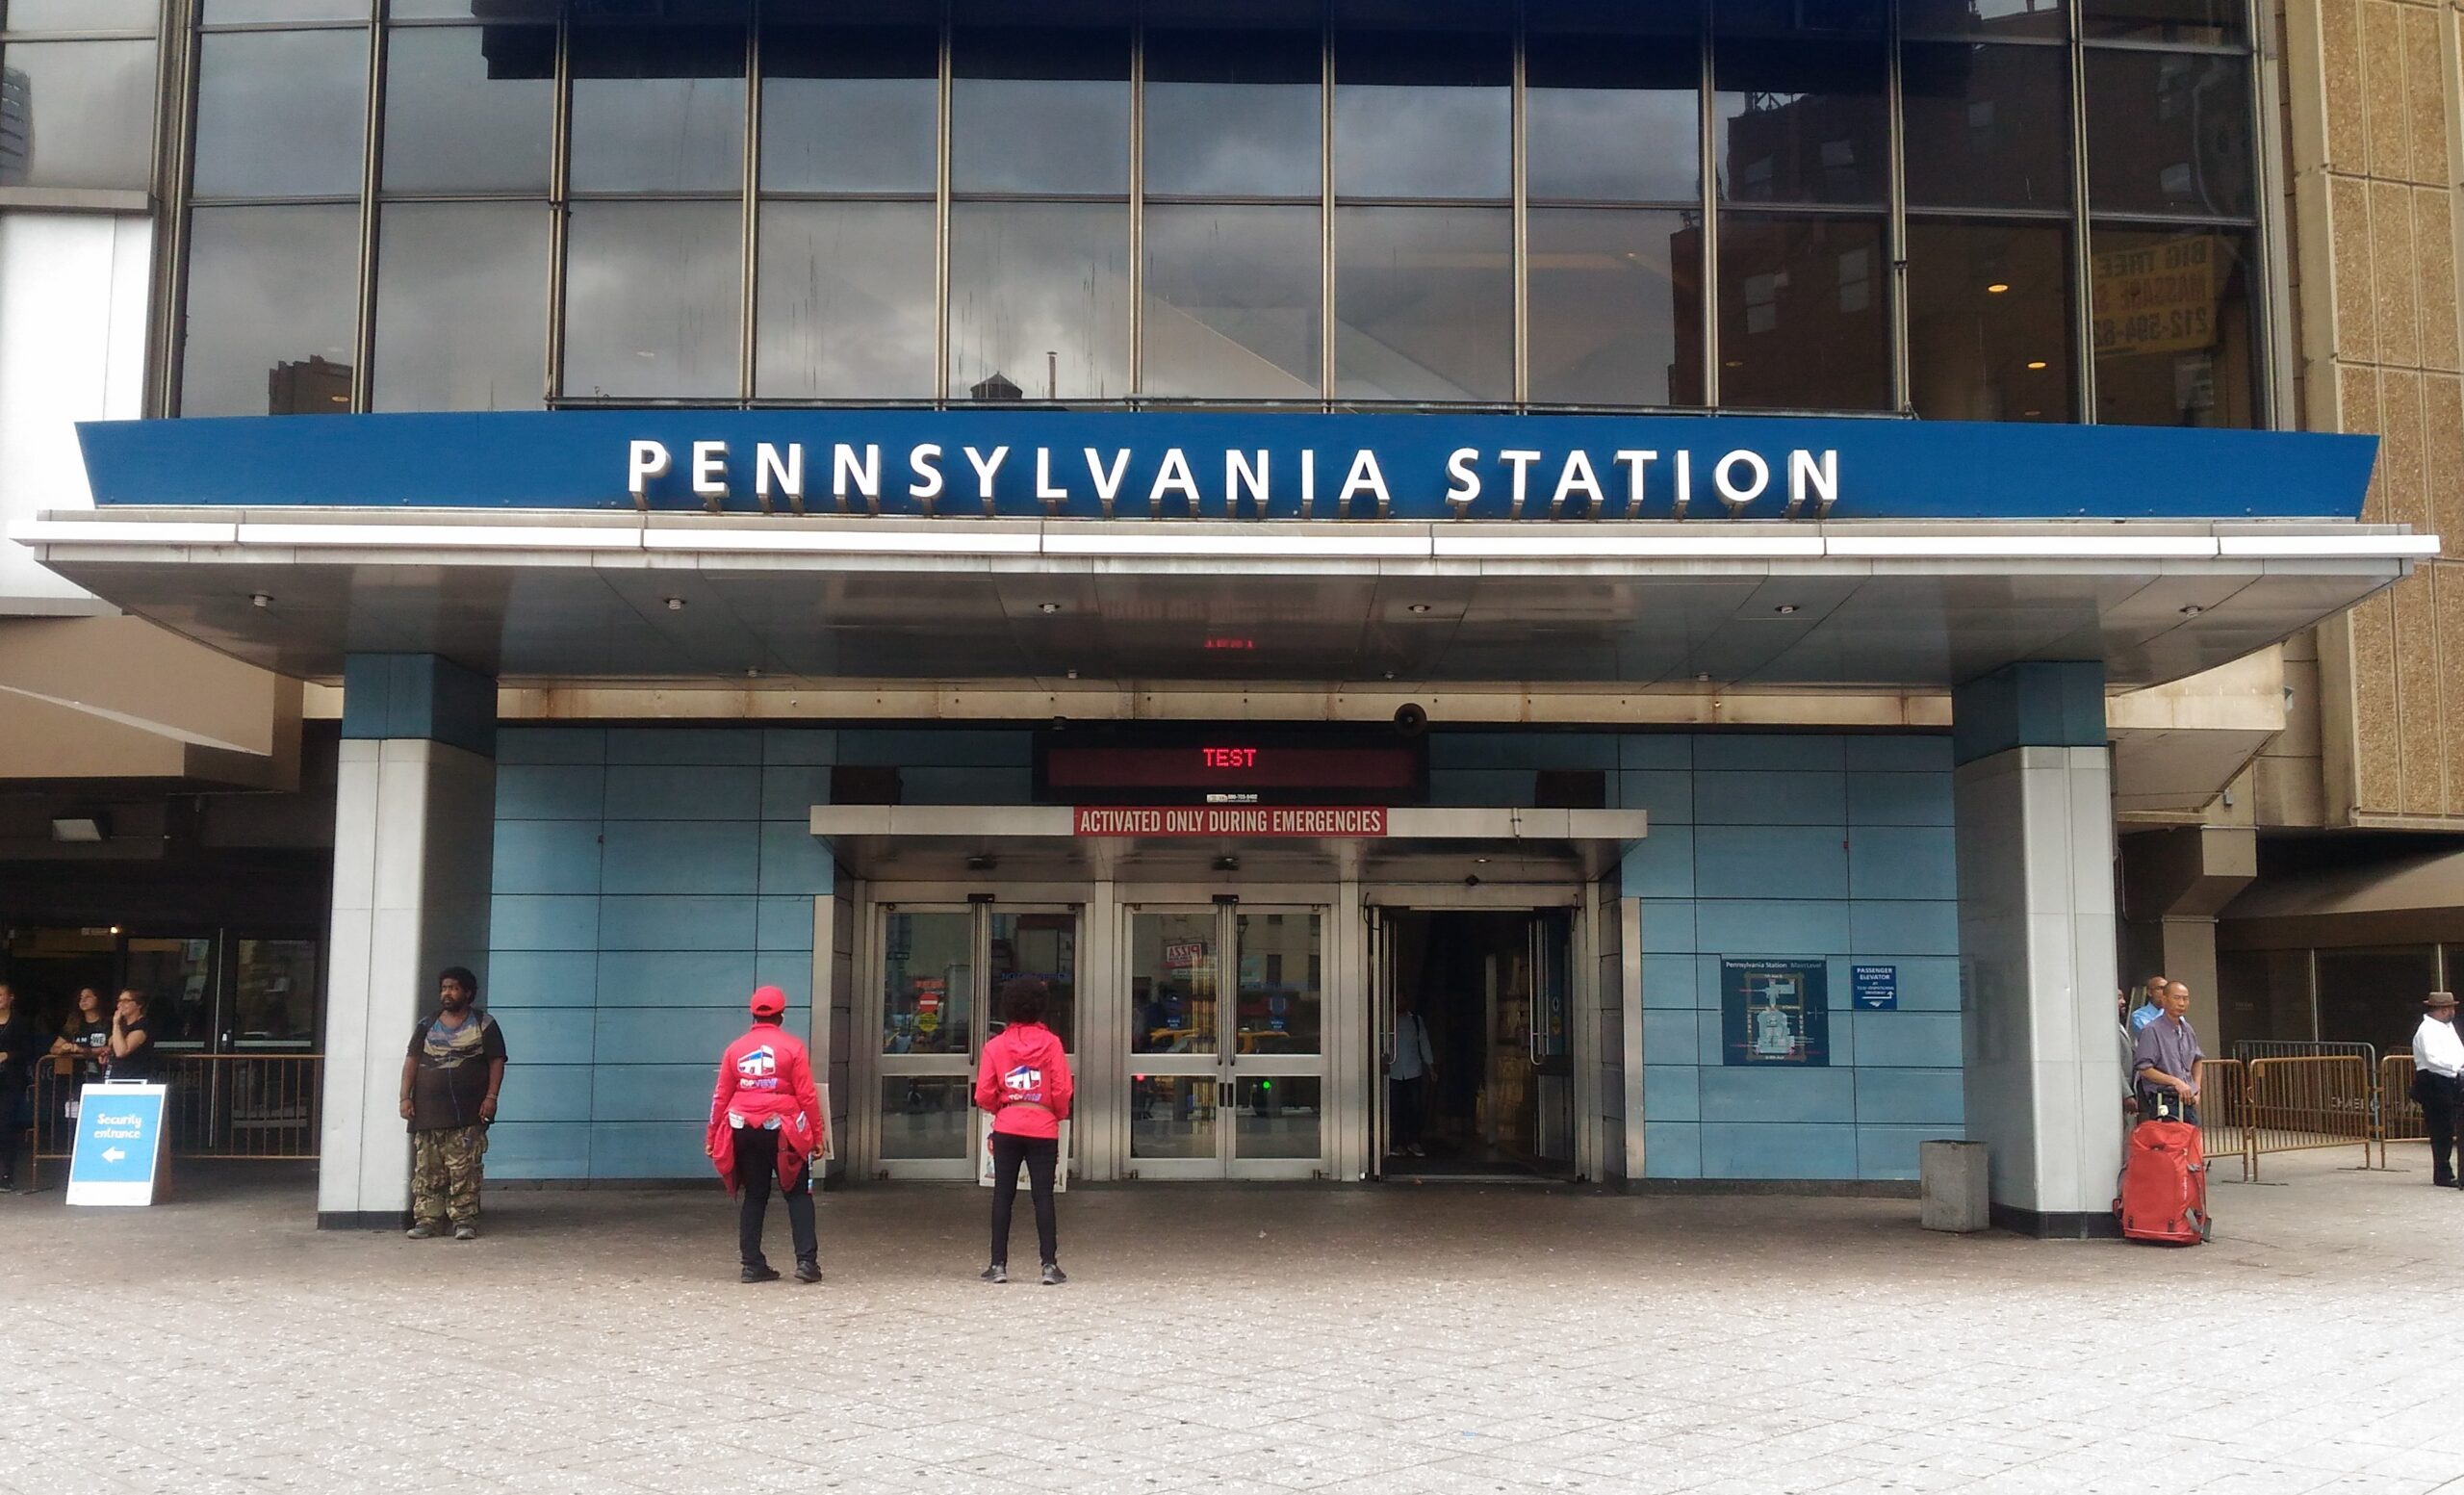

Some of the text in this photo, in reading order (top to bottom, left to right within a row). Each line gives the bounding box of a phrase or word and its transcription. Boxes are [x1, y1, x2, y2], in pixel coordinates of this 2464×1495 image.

[629, 440, 1840, 505] PENNSYLVANIA STATION
[1203, 748, 1257, 767] TEST
[1080, 812, 1381, 833] ACTIVATED ONLY DURING EMERGENCIES
[97, 1113, 143, 1130] Security
[93, 1127, 141, 1140] entrance
